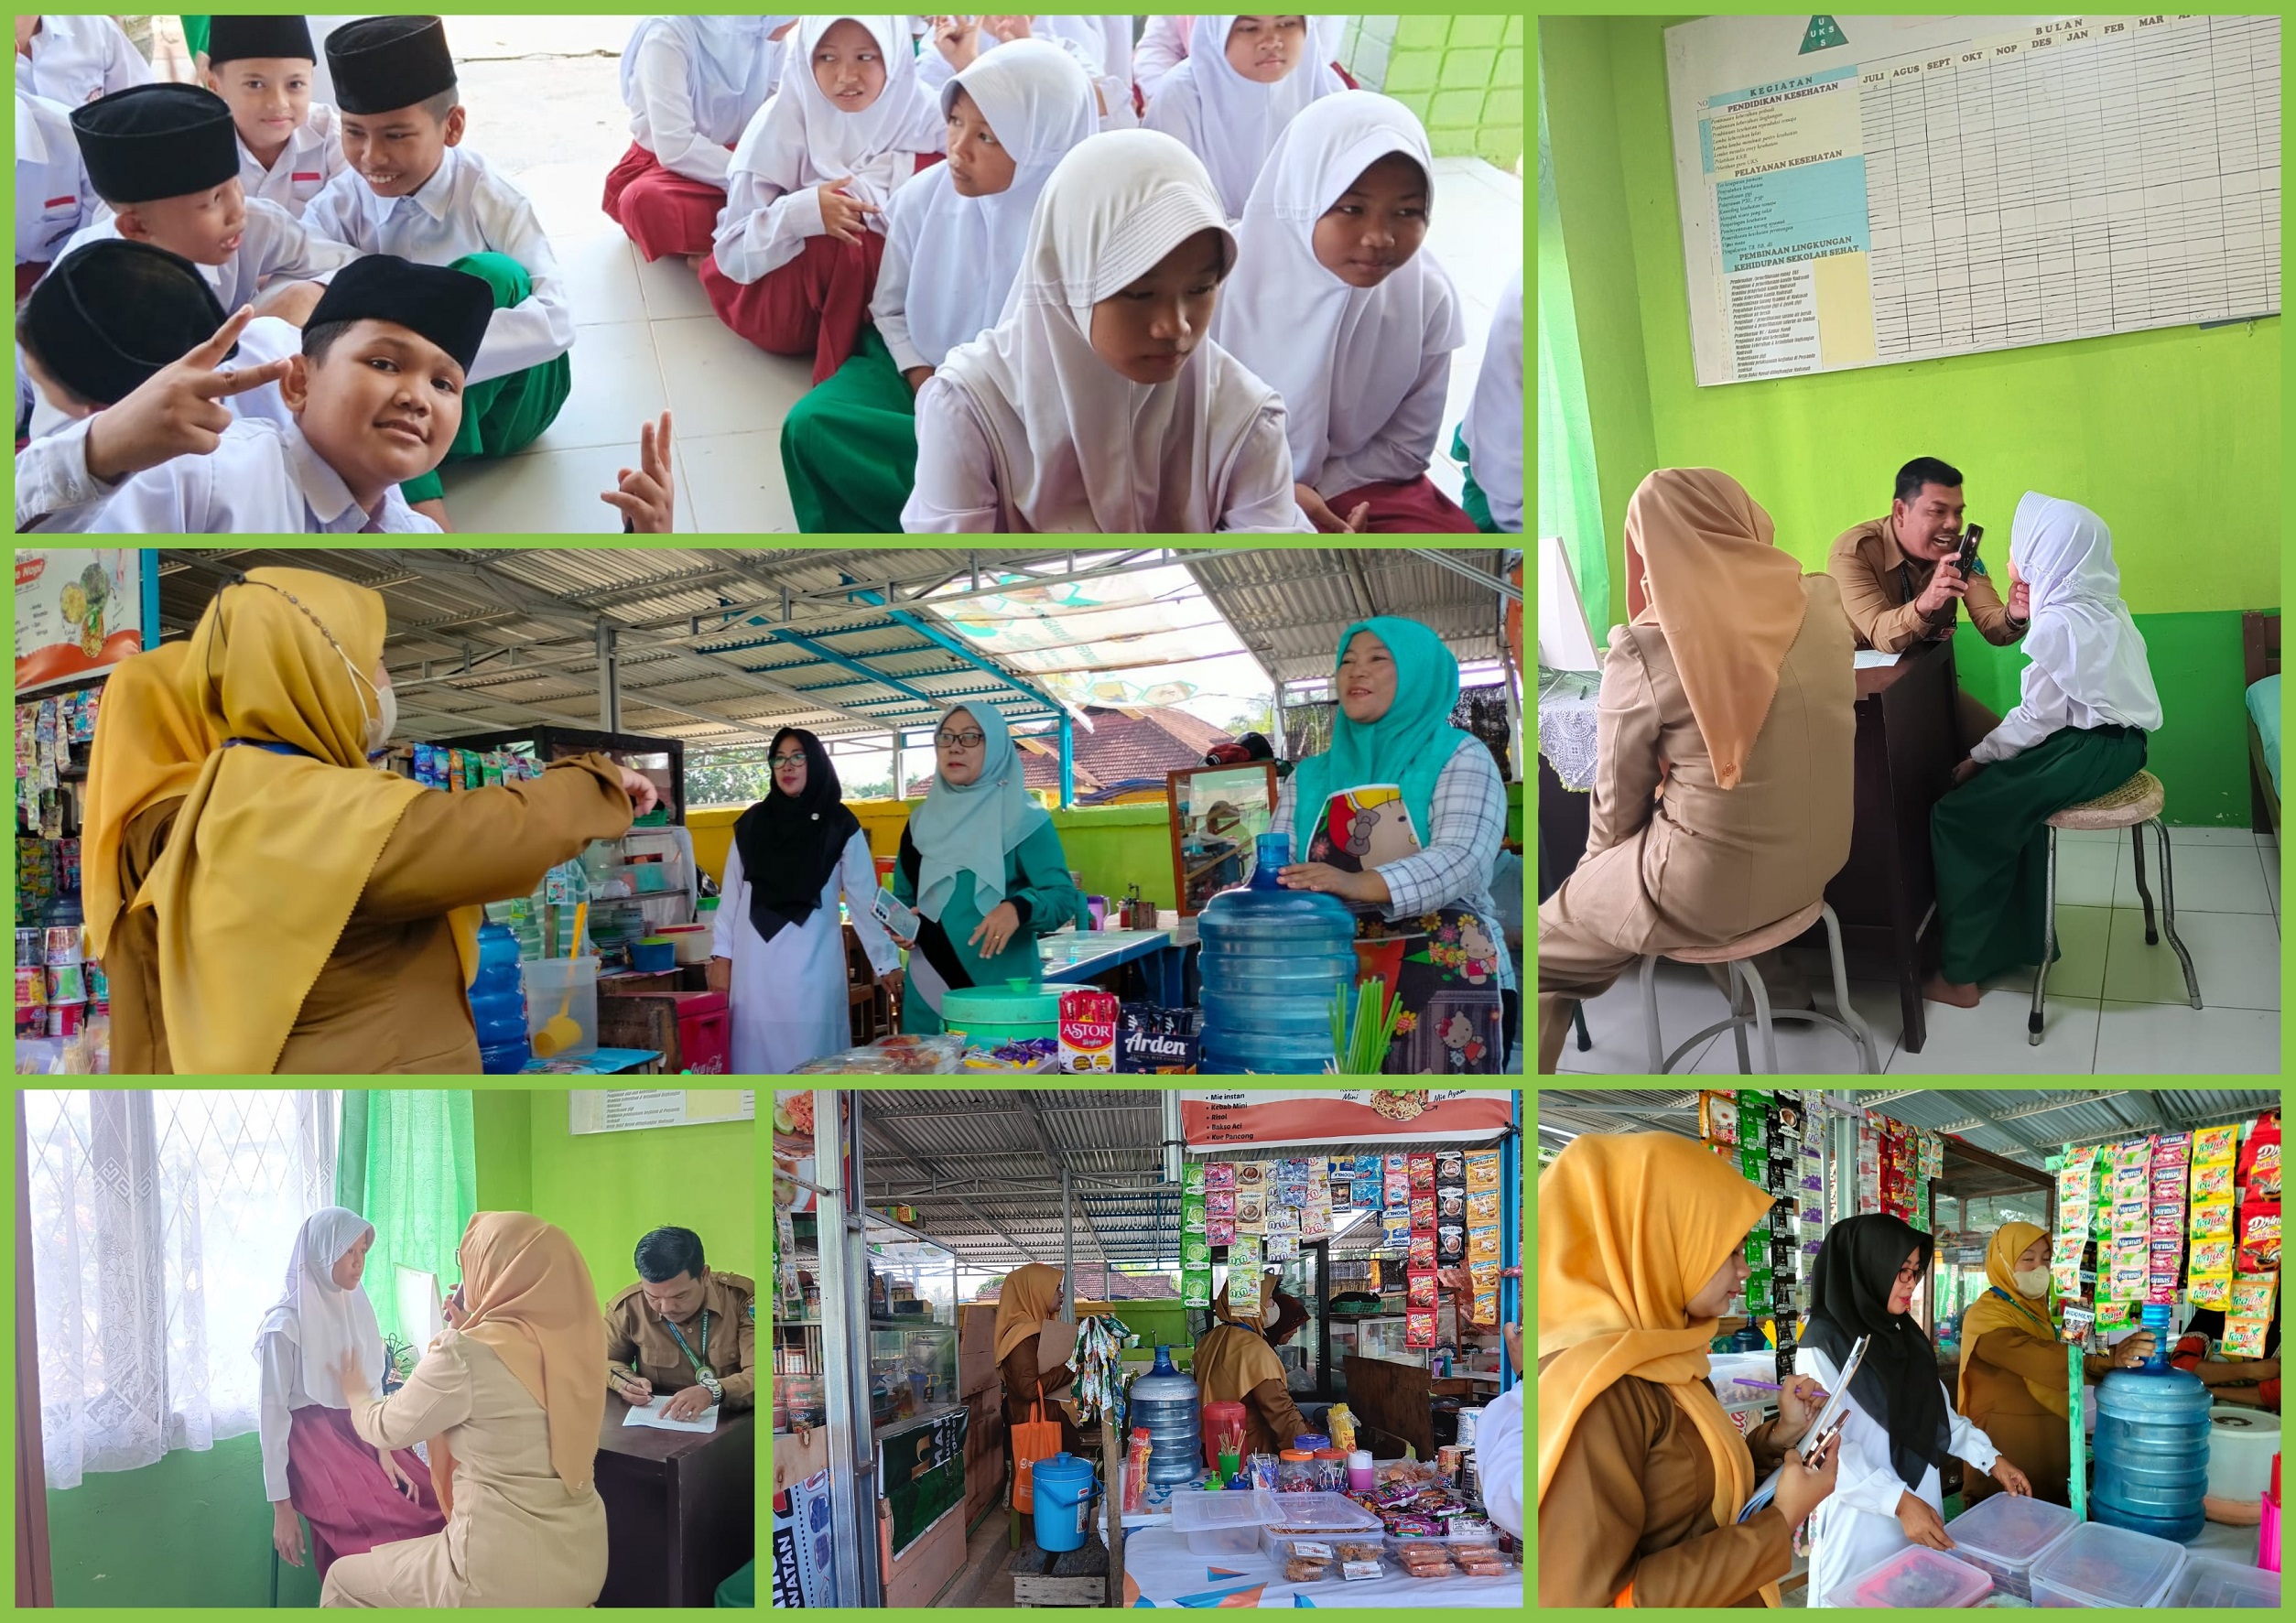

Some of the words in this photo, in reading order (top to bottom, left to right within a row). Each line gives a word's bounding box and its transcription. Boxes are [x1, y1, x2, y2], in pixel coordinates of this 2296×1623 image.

[1863, 72, 1884, 83] JULI
[1892, 65, 1920, 77] AGUS
[1926, 58, 1950, 70] SEPT
[1962, 51, 1983, 63] OKT
[1996, 45, 2018, 56] NOP
[2031, 38, 2052, 48] DES
[2067, 30, 2088, 41] JAN
[2104, 23, 2124, 34] FEB
[2139, 16, 2163, 27] MAR
[1750, 77, 1813, 97] KEGIATAN
[1727, 93, 1782, 113] PENDIDIKAN
[1784, 82, 1838, 101] KESEHATAN
[1735, 160, 1786, 177] PELAYANAN
[1788, 150, 1842, 167] KESEHATAN
[1739, 246, 1790, 261] PEMBINAAN
[1792, 236, 1852, 253] LINGKUNGAN
[1734, 257, 1785, 272] KEHIDUPAN
[1787, 251, 1827, 263] SEKOLAH
[1828, 245, 1859, 256] SEHAT
[1063, 1023, 1110, 1039] ASTOR
[1125, 1033, 1186, 1055] Arden
[1434, 1094, 1446, 1102] Mie
[2161, 1135, 2183, 1144] Marimas
[2199, 1140, 2228, 1152] Teajus
[2120, 1169, 2141, 1178] Marimas
[2156, 1172, 2179, 1181] Marimas
[2119, 1204, 2140, 1213] Marimas
[2154, 1206, 2177, 1215] Marimas
[2196, 1215, 2226, 1228] Teajus
[2193, 1288, 2223, 1300] Teajus
